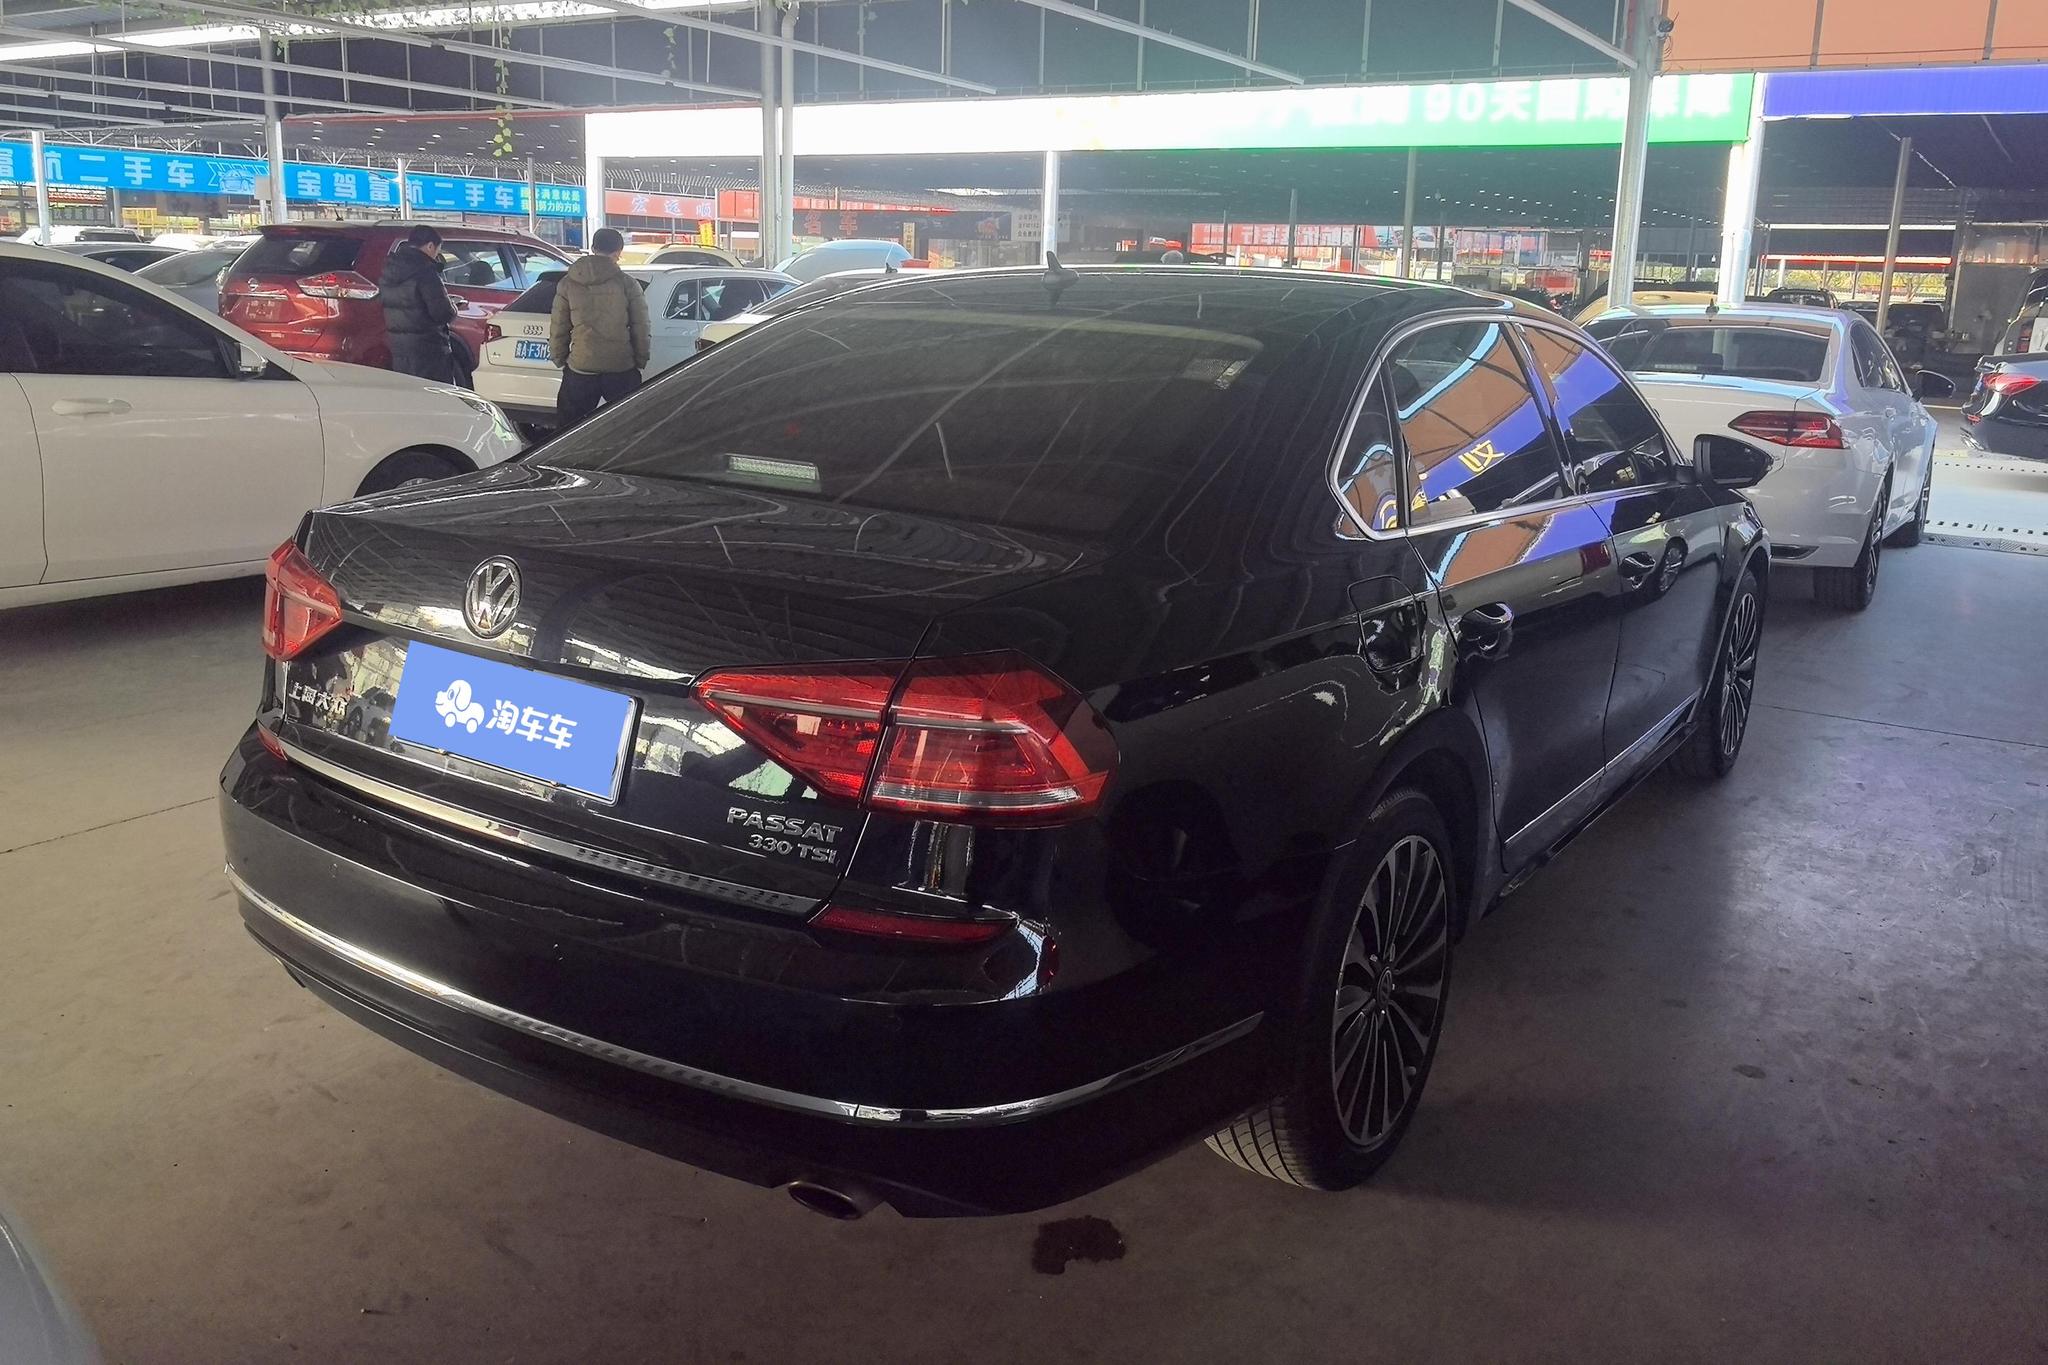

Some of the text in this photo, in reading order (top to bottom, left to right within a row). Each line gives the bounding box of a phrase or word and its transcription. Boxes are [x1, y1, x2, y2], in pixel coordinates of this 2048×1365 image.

[726, 806, 843, 843] PASSAT
[748, 833, 837, 864] 330 TSI
